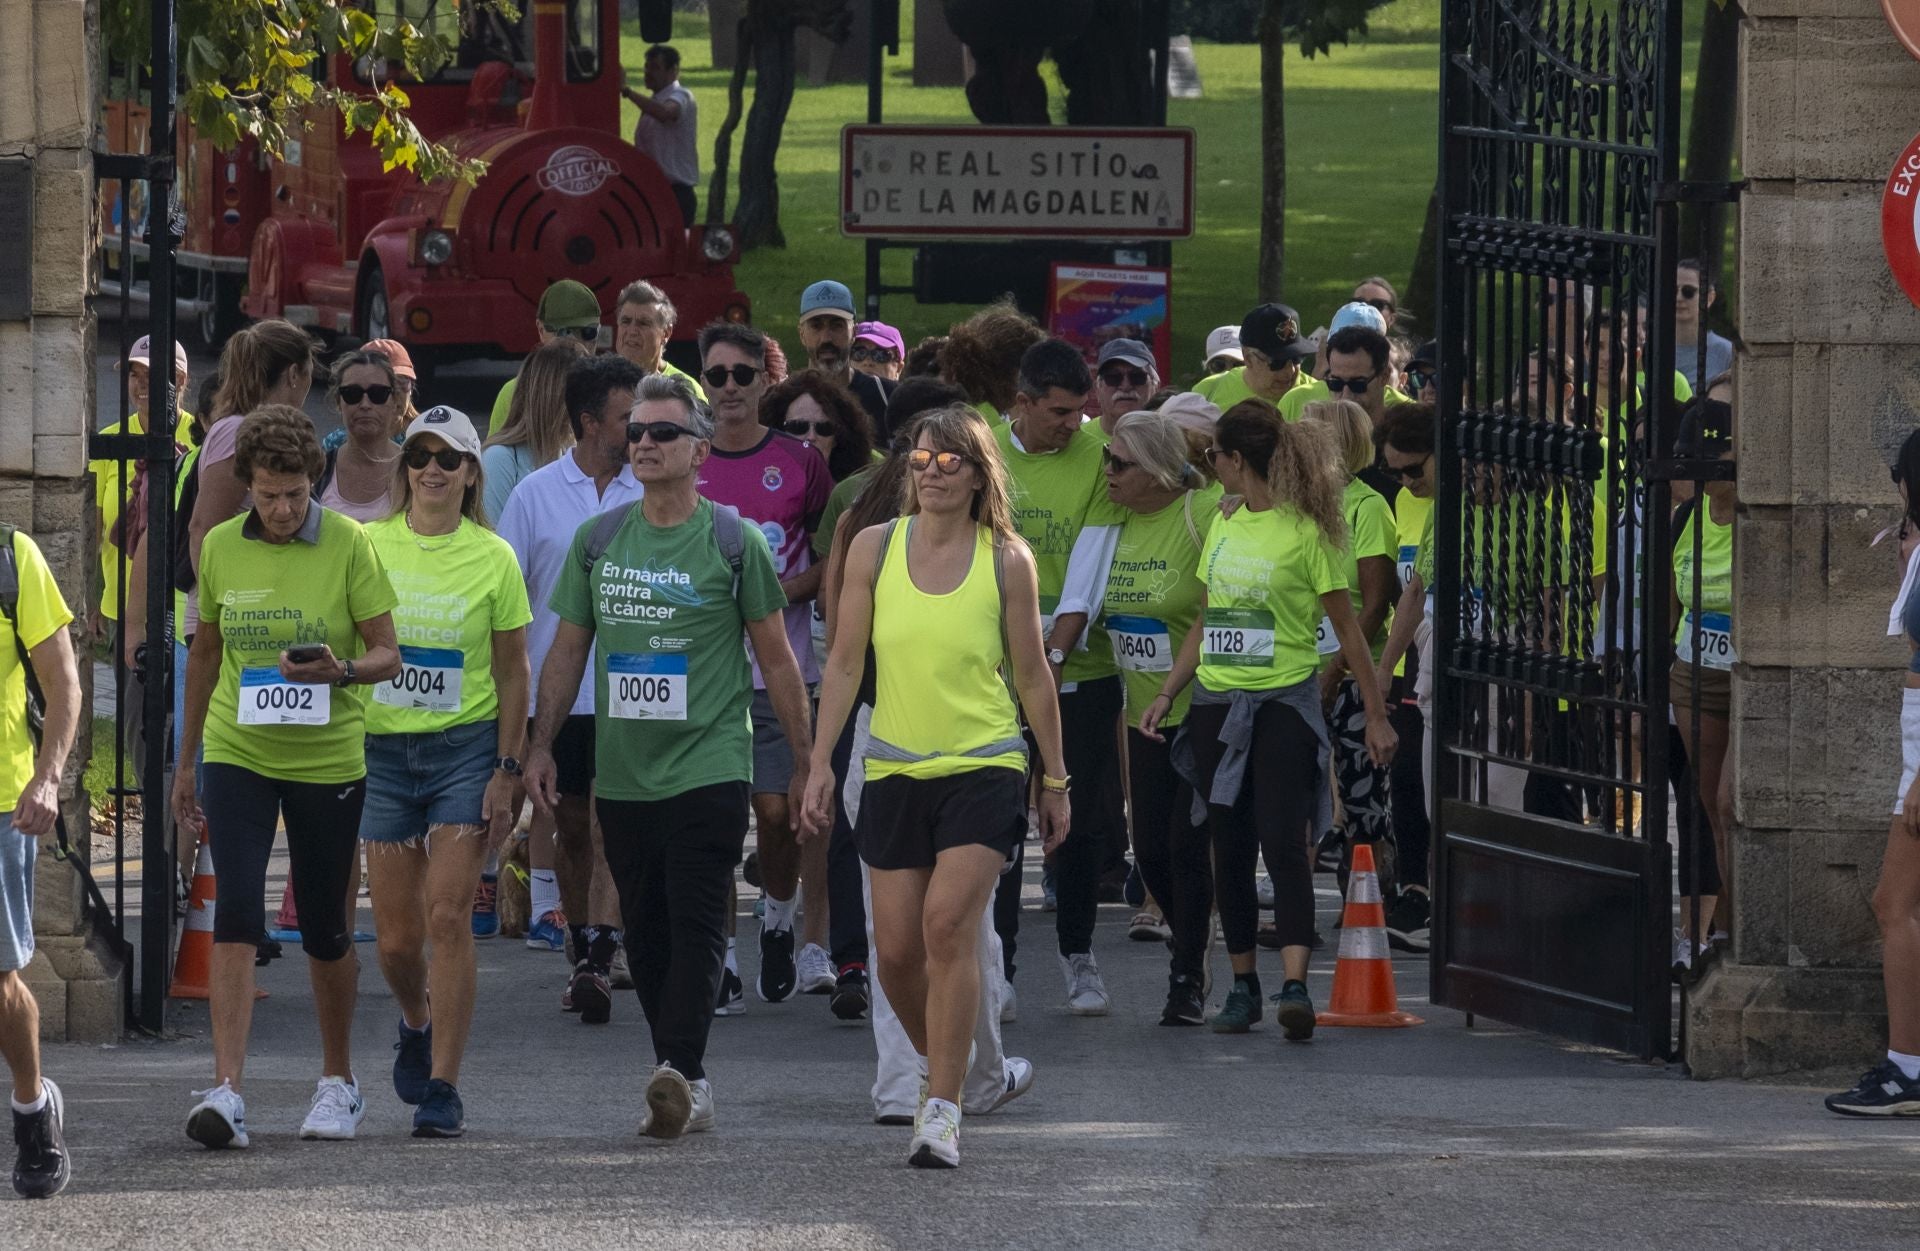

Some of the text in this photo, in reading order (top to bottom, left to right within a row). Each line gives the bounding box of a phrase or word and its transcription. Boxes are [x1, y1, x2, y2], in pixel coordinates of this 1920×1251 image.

[546, 160, 617, 183] OFFICIAL
[909, 151, 1127, 178] REAL SITIO
[1893, 146, 1920, 197] EXC
[863, 188, 1172, 216] DE LA MAGDALENA
[601, 561, 691, 586] En marcha
[1118, 557, 1167, 573] marcha
[414, 591, 468, 608] marcha
[599, 582, 652, 601] contra
[1106, 589, 1152, 603] cáncer
[223, 606, 303, 621] En marcha
[396, 604, 465, 622] ontra el
[600, 597, 677, 620] el cáncer
[223, 623, 270, 637] contra
[397, 618, 465, 645] áncer
[1208, 630, 1244, 653] 1128
[240, 638, 292, 651] cáncer
[1118, 634, 1157, 659] 0640
[391, 667, 446, 696] 0004
[619, 676, 671, 703] 0006
[256, 686, 313, 710] 0002
